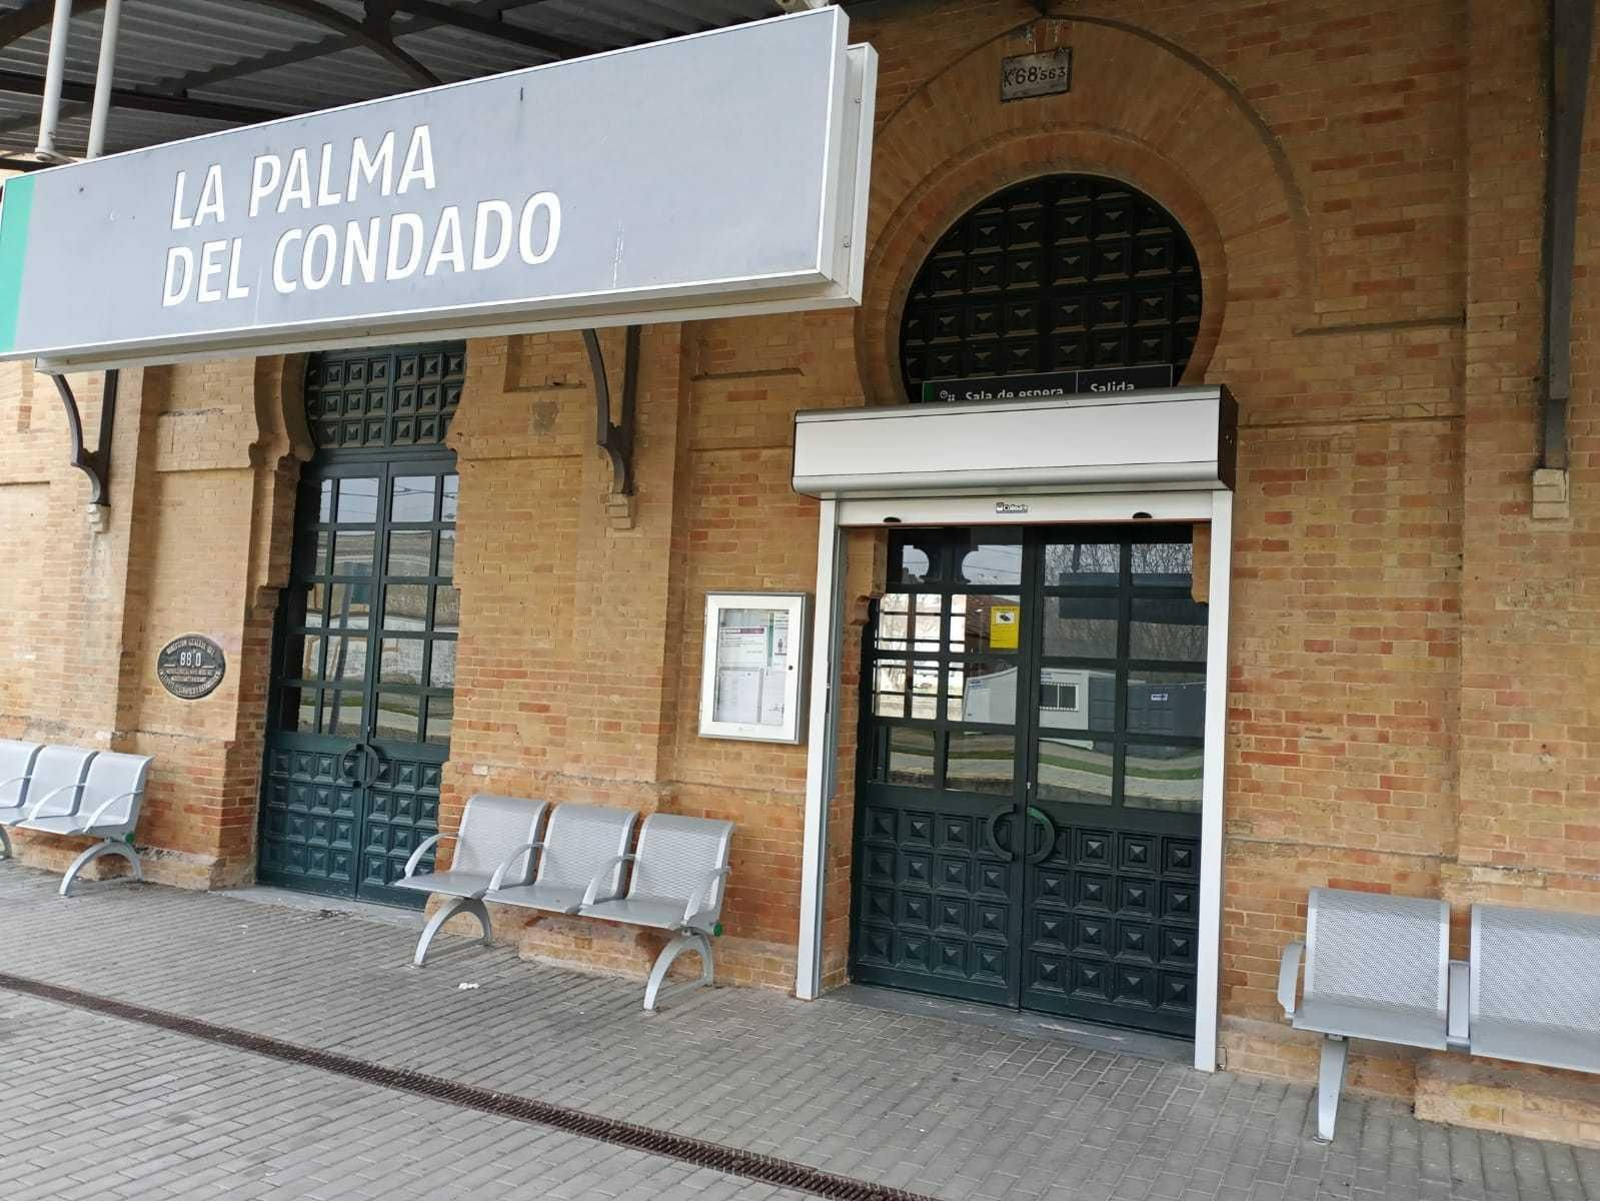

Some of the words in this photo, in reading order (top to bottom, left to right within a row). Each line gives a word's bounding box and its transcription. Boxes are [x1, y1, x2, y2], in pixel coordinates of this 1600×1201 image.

[171, 164, 225, 230] LA
[248, 125, 436, 217] PALMA
[162, 237, 249, 307] DEL
[271, 191, 562, 294] CONDADO
[965, 390, 993, 401] Sala
[1090, 381, 1135, 393] Salida
